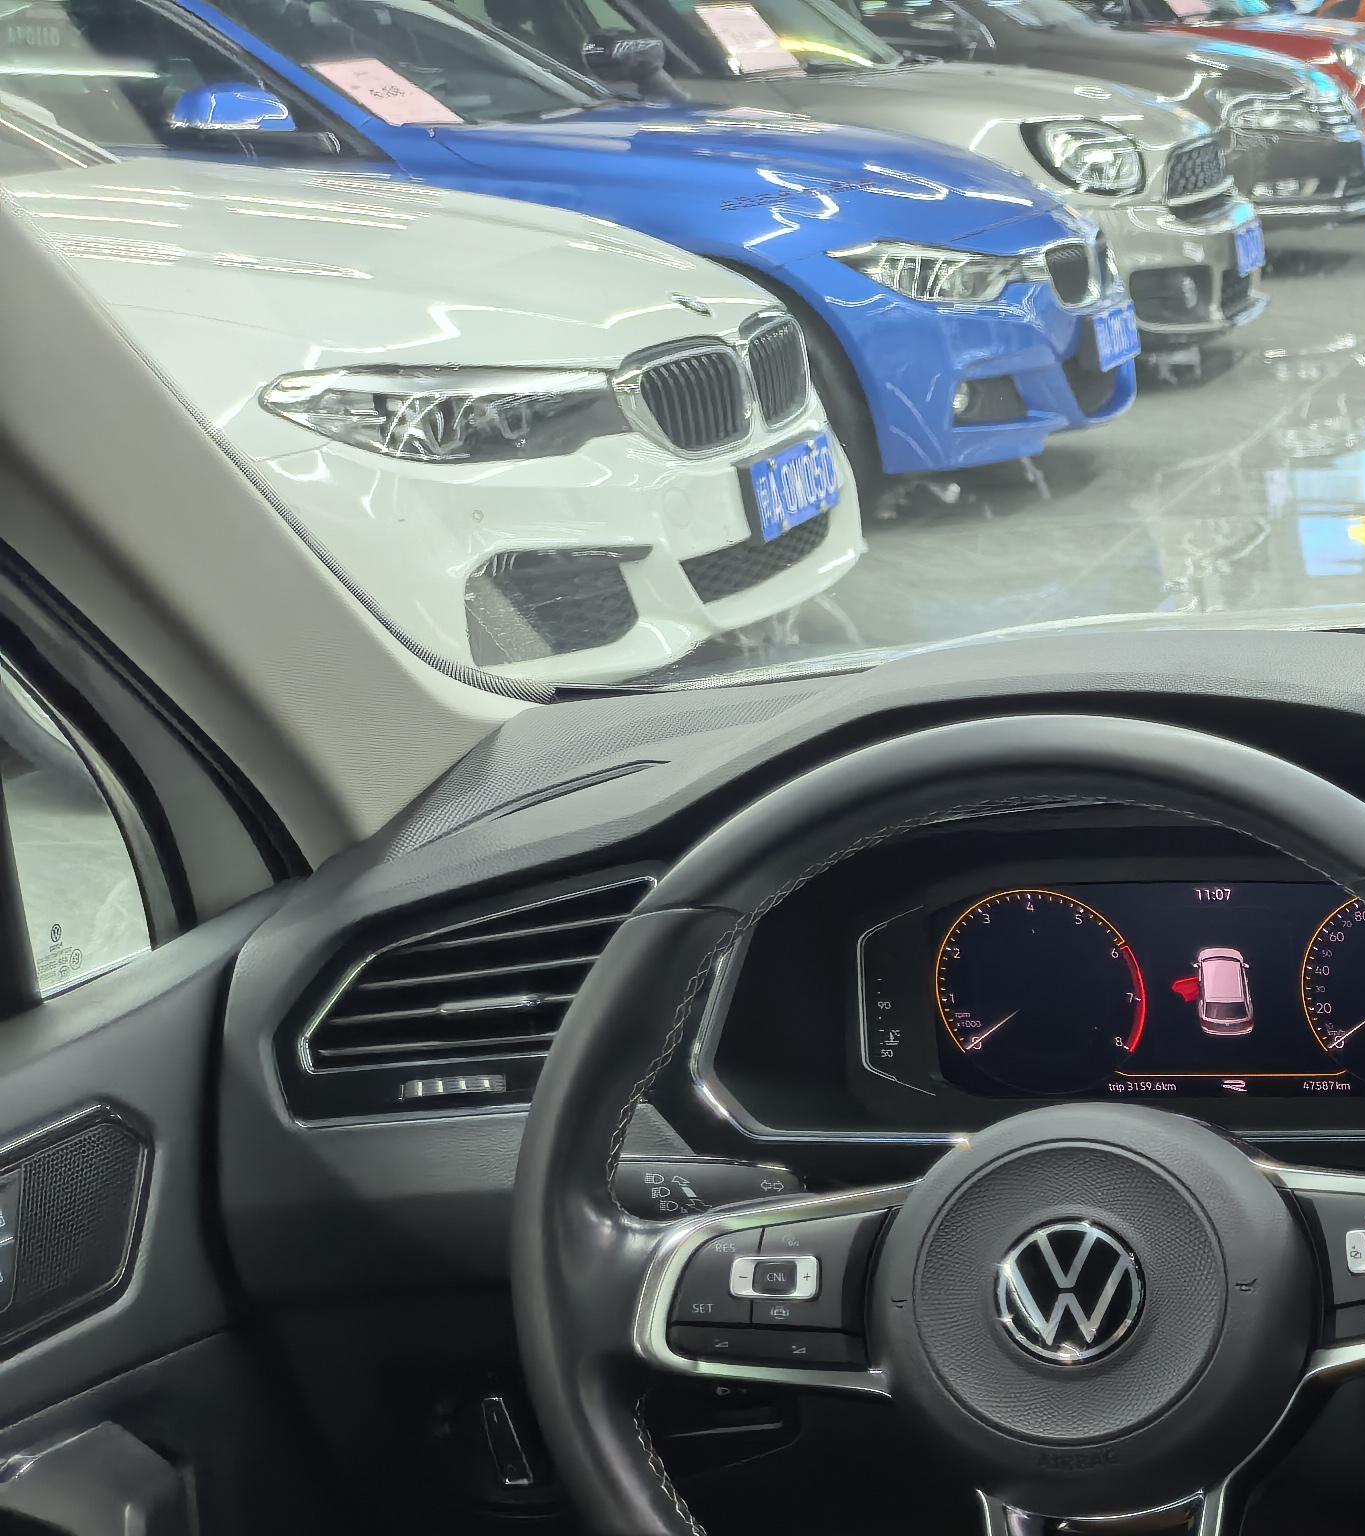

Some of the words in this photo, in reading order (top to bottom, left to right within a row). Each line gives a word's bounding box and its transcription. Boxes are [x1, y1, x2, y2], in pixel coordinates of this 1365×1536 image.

[1196, 889, 1231, 901] 11:07
[1026, 902, 1035, 913] 4
[984, 914, 991, 924] 3
[1075, 914, 1083, 925] 5
[1329, 931, 1345, 942] 60
[953, 948, 961, 959] 2
[1111, 949, 1119, 959] 6
[1315, 965, 1330, 976] 40
[1127, 993, 1134, 1003] 7
[878, 1001, 891, 1010] 90
[1317, 1003, 1332, 1014] 20
[1115, 1036, 1123, 1047] 8
[1108, 1083, 1125, 1095] trip
[715, 1243, 736, 1253] RES
[766, 1272, 786, 1282] CNL
[692, 1303, 713, 1314] SET
